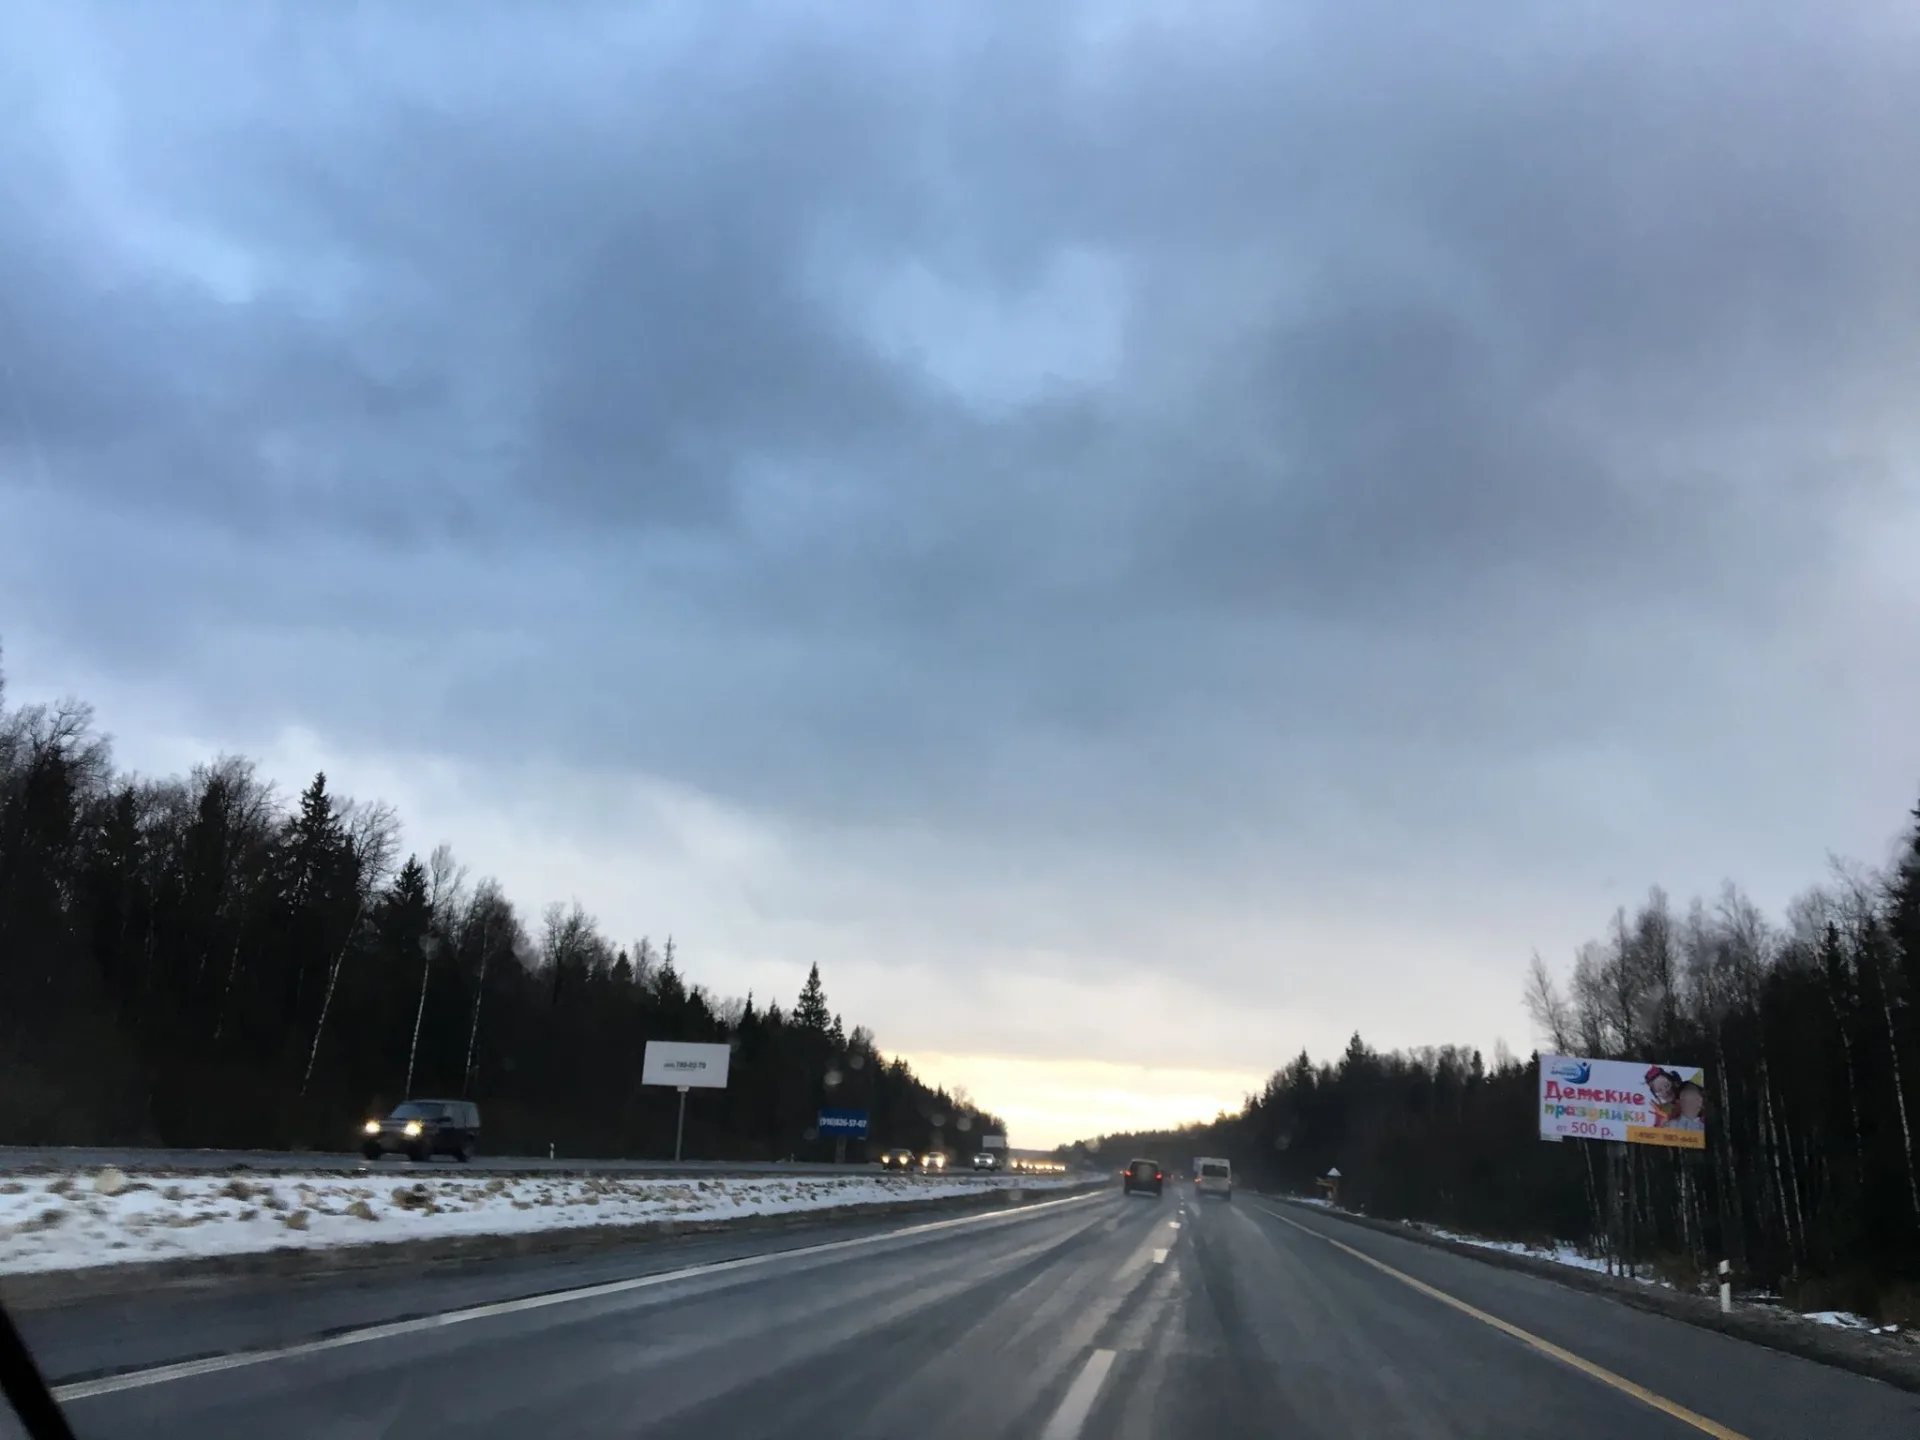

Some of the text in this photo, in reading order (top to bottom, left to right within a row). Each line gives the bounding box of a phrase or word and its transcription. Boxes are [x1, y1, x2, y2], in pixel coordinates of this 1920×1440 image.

[1544, 1080, 1646, 1106] Детские
[1544, 1103, 1646, 1122] праздники
[1571, 1121, 1597, 1135] 500
